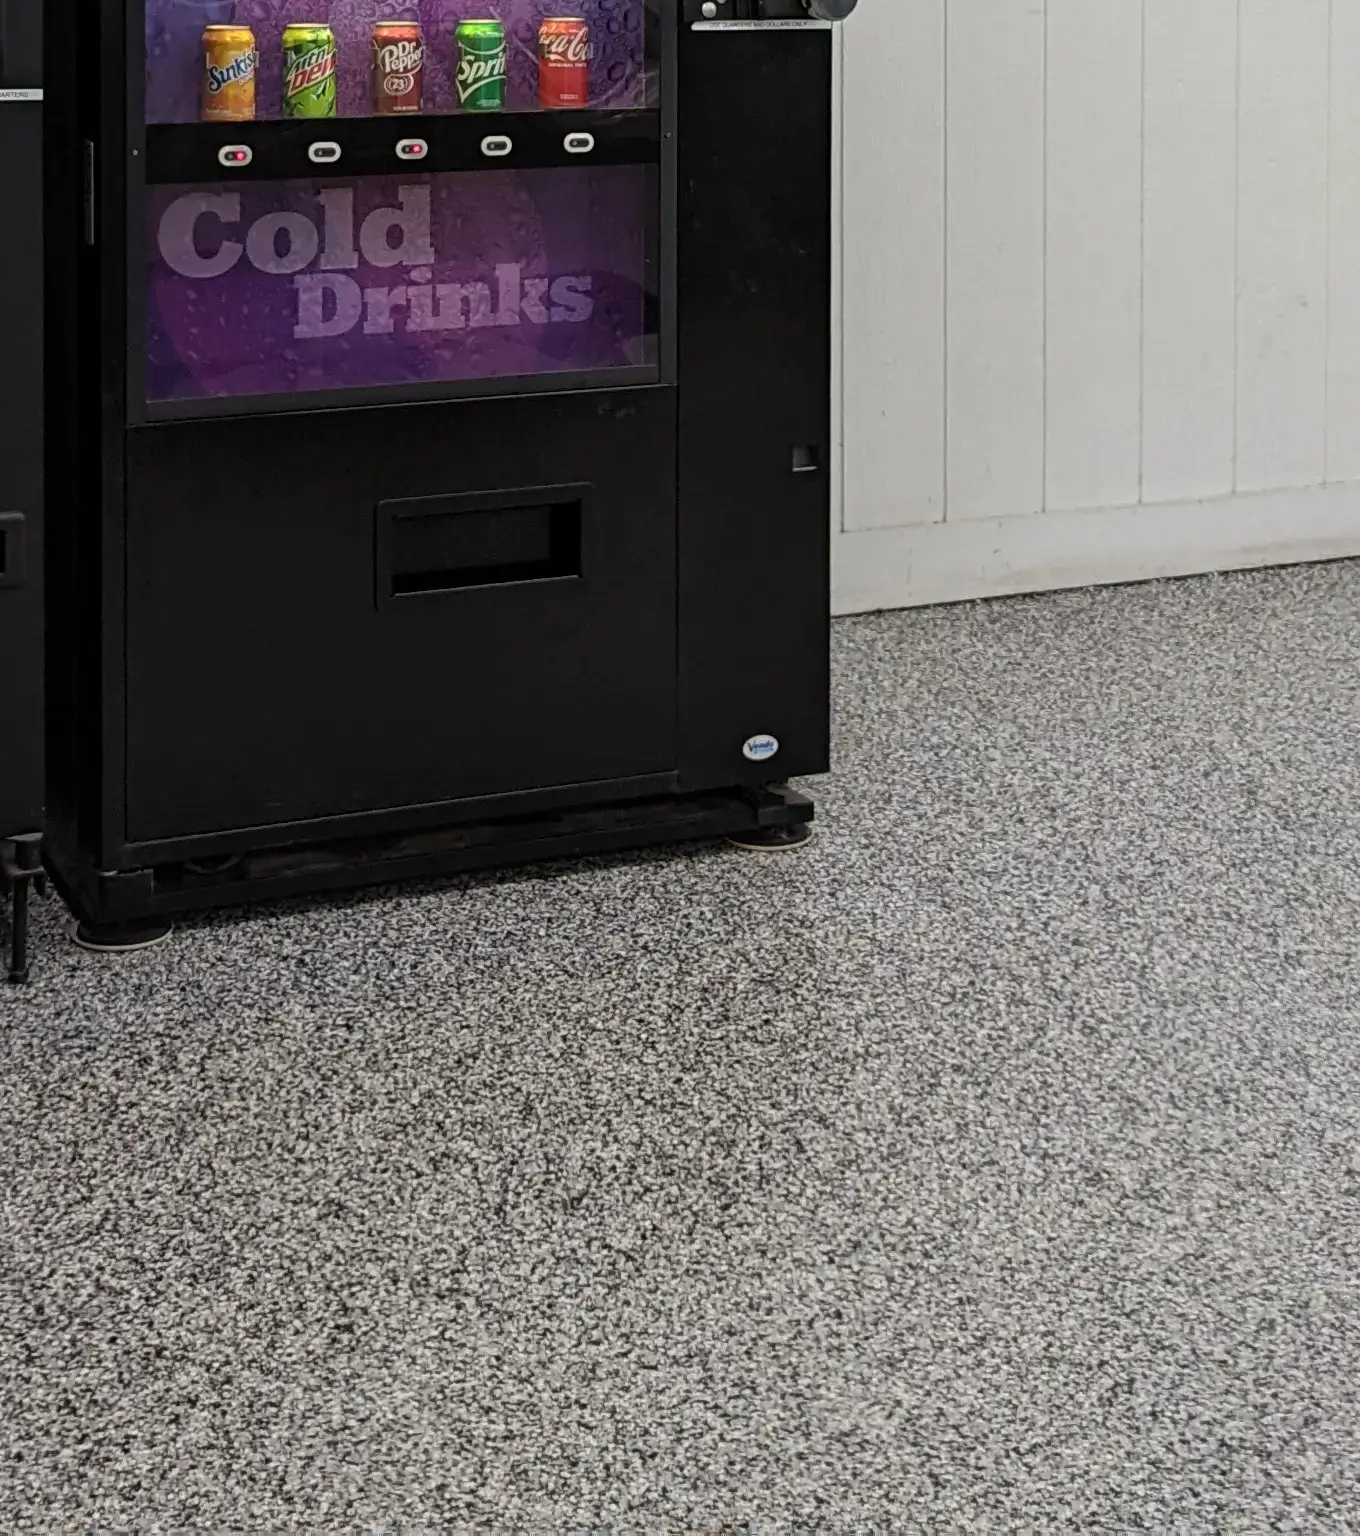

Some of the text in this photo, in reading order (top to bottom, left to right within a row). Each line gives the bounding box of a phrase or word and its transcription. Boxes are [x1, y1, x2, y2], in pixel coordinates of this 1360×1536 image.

[380, 45, 423, 73] Pepper
[397, 41, 417, 57] Dr
[392, 78, 405, 90] 23
[157, 184, 435, 278] Cold
[293, 263, 593, 339] Drinks
